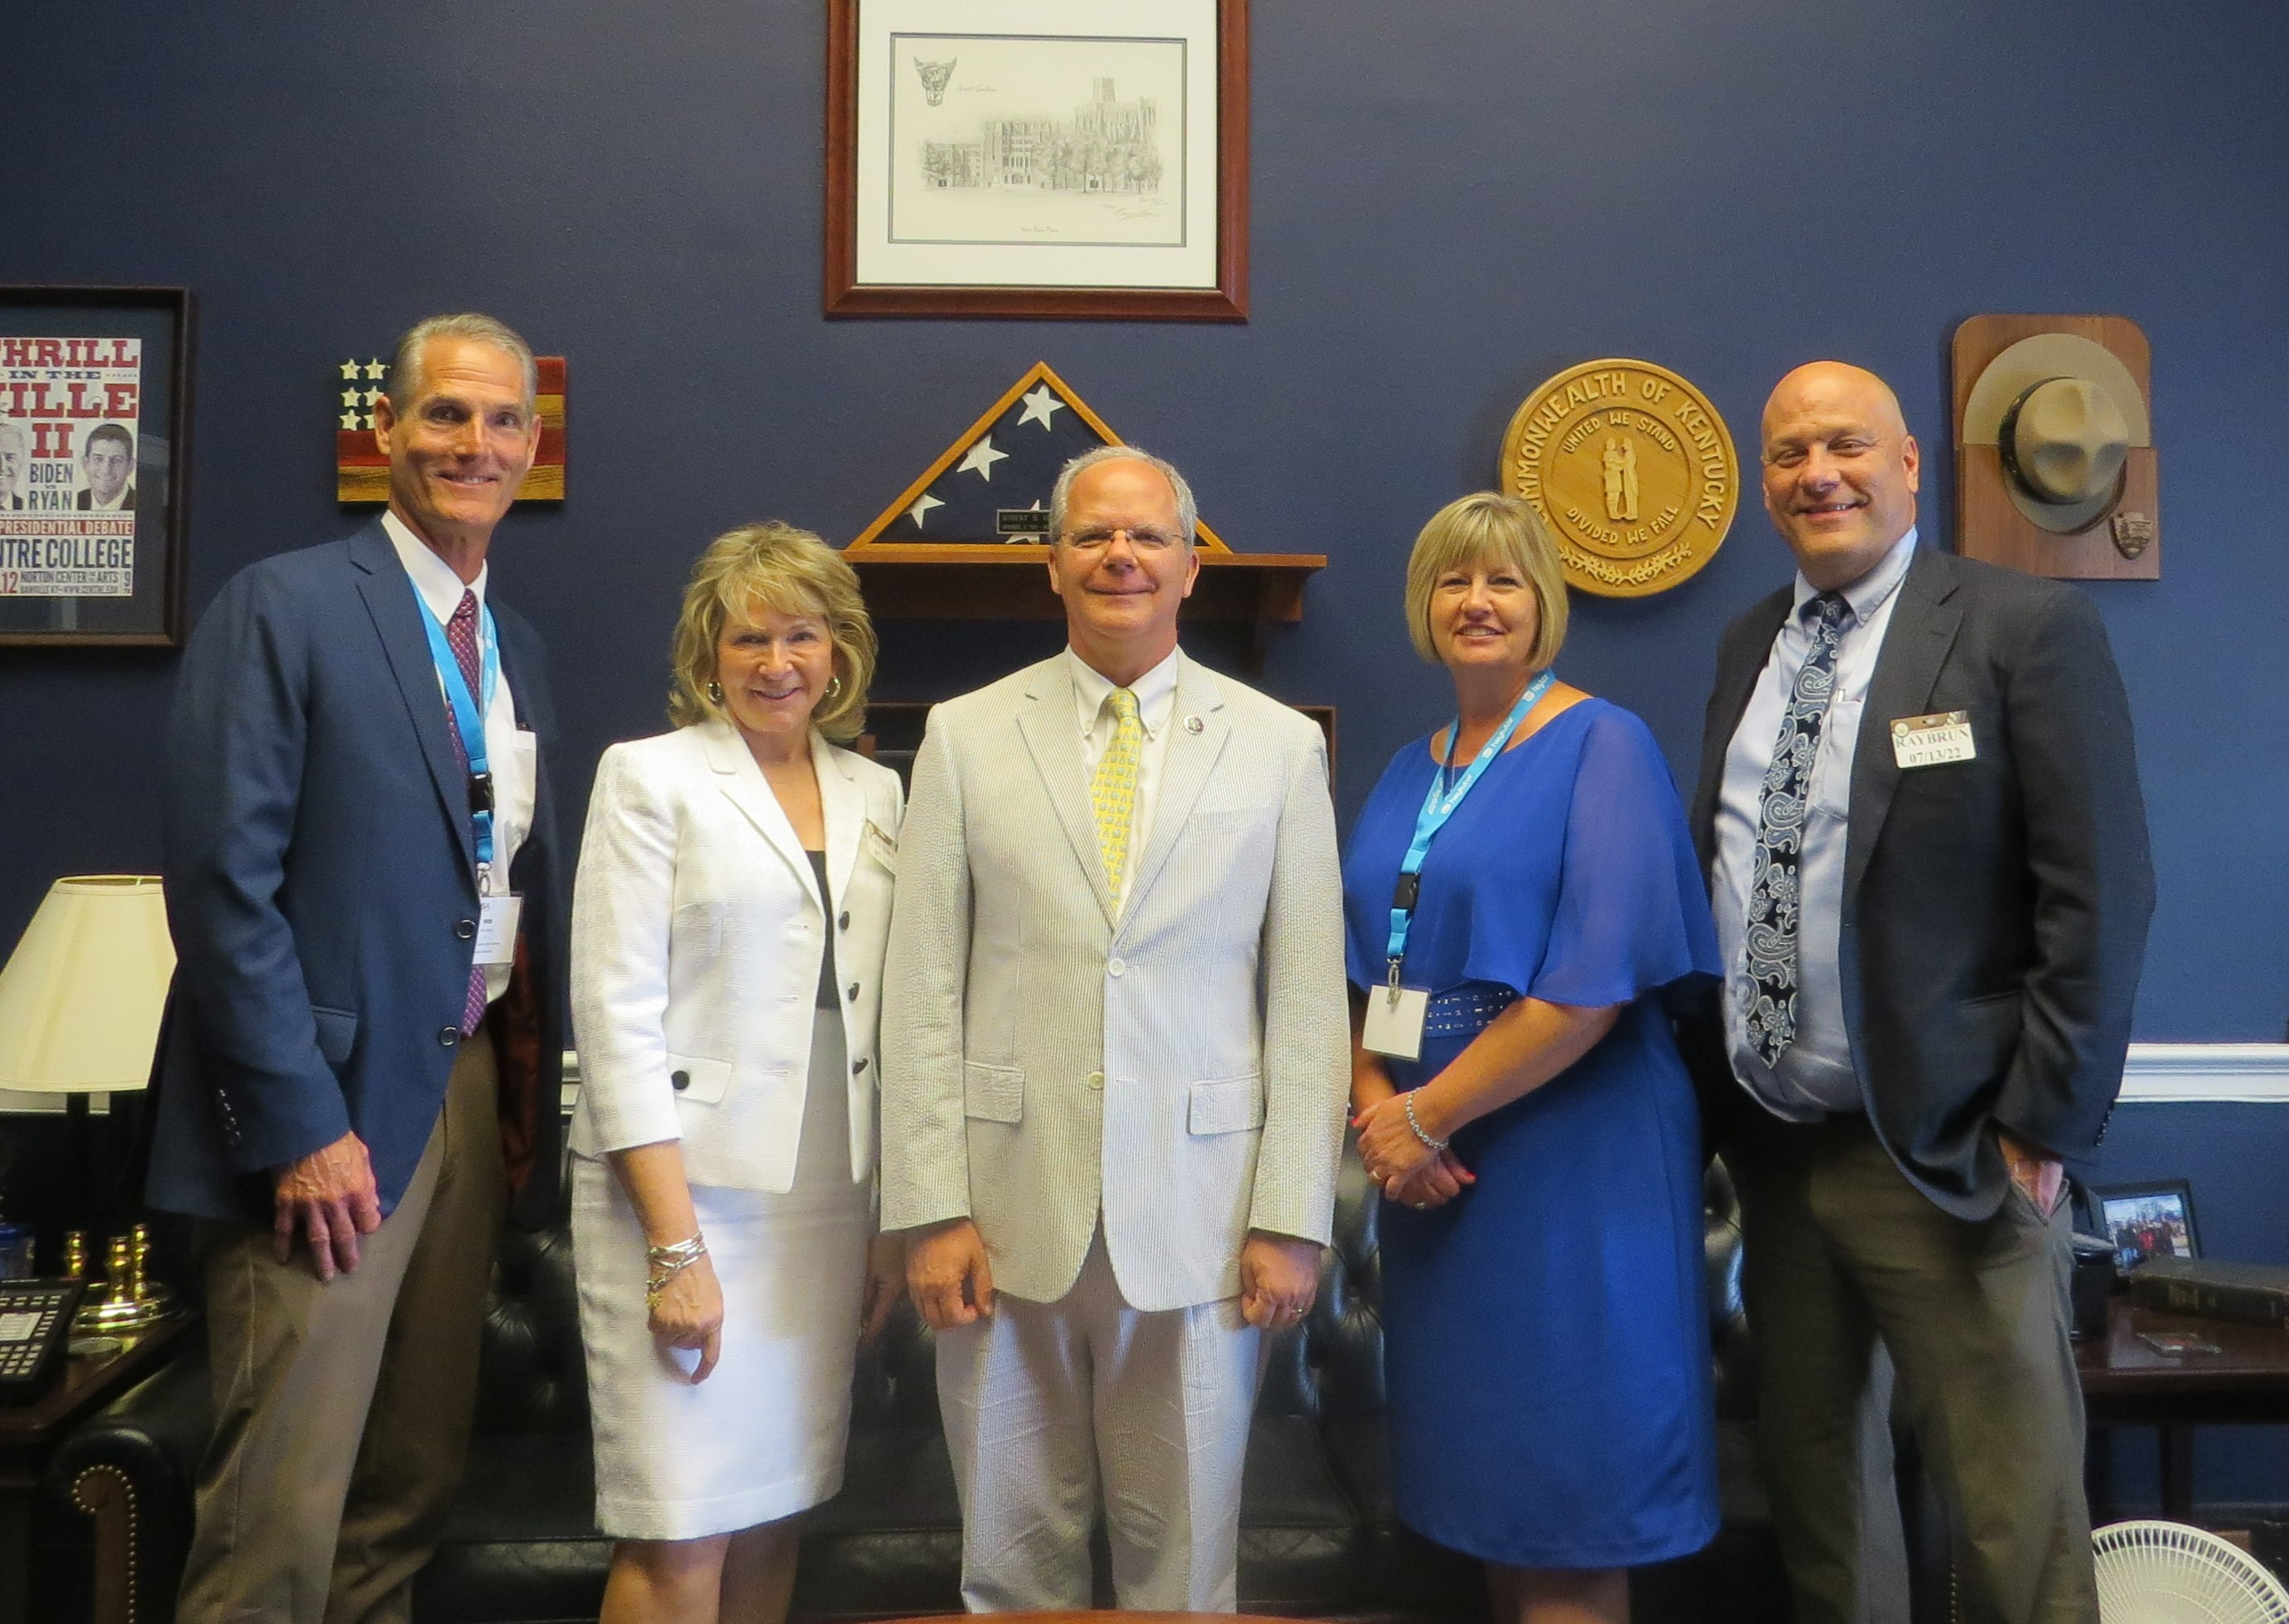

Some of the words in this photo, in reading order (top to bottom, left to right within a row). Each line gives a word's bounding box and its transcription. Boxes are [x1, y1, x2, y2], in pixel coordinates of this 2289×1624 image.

[0, 340, 138, 367] HRILL
[9, 370, 38, 379] IN
[46, 370, 101, 379] THE
[0, 383, 137, 418] ILLE
[31, 423, 75, 458] II
[1563, 417, 1601, 453] UNITED
[1608, 412, 1630, 426] WE
[1636, 417, 1675, 451] STAND
[1641, 378, 1670, 403] OF
[1675, 399, 1726, 529] KENTUCKY
[30, 463, 73, 483] BIDEN
[29, 490, 72, 510] RYAN
[85, 521, 132, 534] DEBATE
[1566, 507, 1618, 544] DIVIDED
[1626, 528, 1647, 544] WE
[1650, 506, 1679, 534] FALL
[46, 538, 132, 568] COLLEGE
[55, 571, 86, 583] CENTER
[97, 571, 118, 583] ARTS
[124, 571, 131, 587] 9
[1909, 747, 1962, 764] 07/13/22
